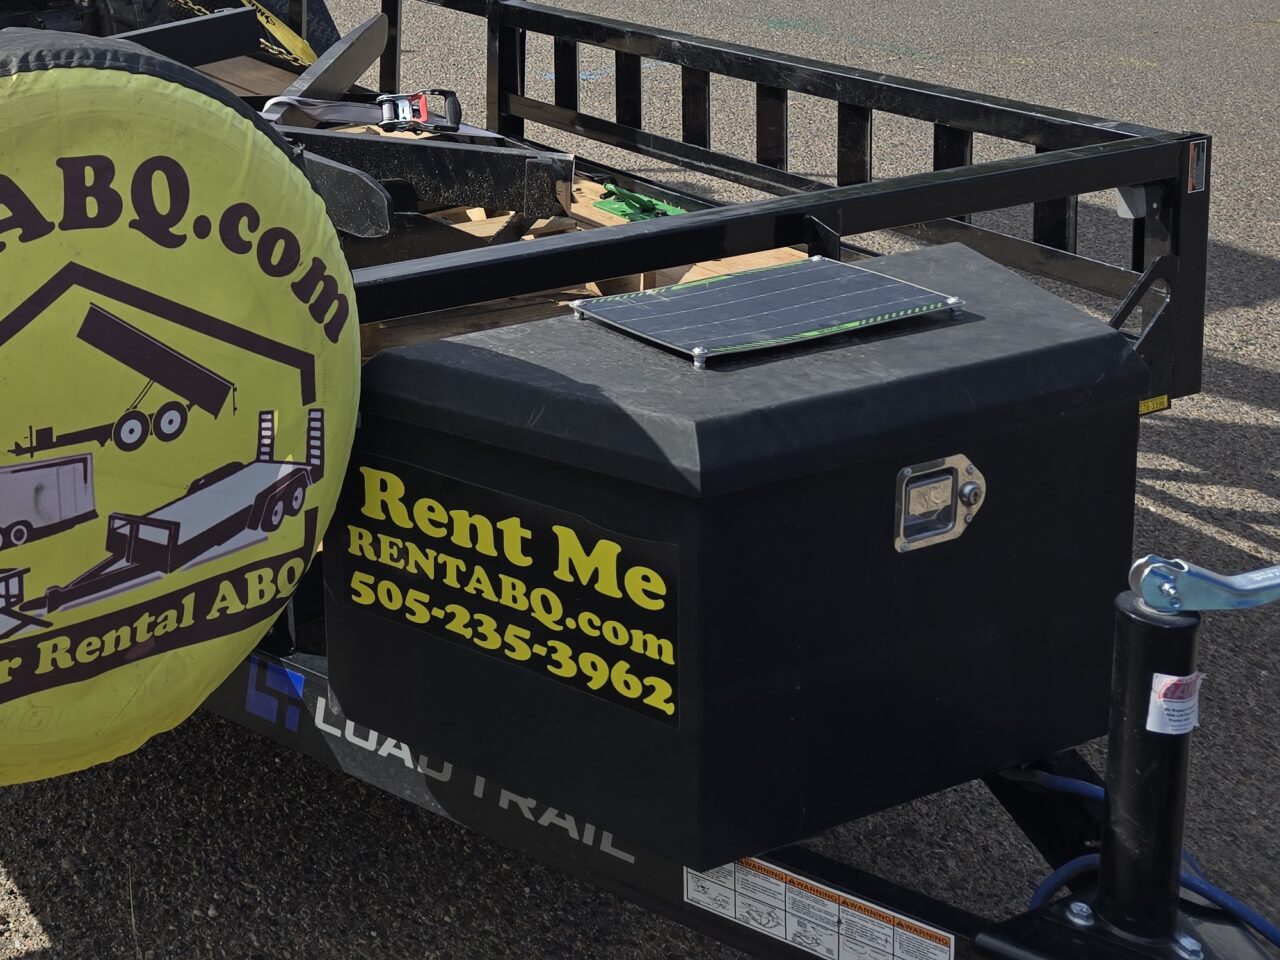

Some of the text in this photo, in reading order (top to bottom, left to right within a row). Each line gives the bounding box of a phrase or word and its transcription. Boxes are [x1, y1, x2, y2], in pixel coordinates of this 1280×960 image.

[359, 466, 668, 611] Rent Me
[34, 592, 195, 675] Rental
[206, 557, 305, 620] ABQ
[347, 524, 676, 665] RENTABQ.com
[350, 570, 676, 716] 505-235-3962
[743, 858, 784, 881] WARNING
[795, 880, 838, 903] WARNING
[847, 901, 893, 924] WARNING
[902, 921, 949, 945] WARNING
